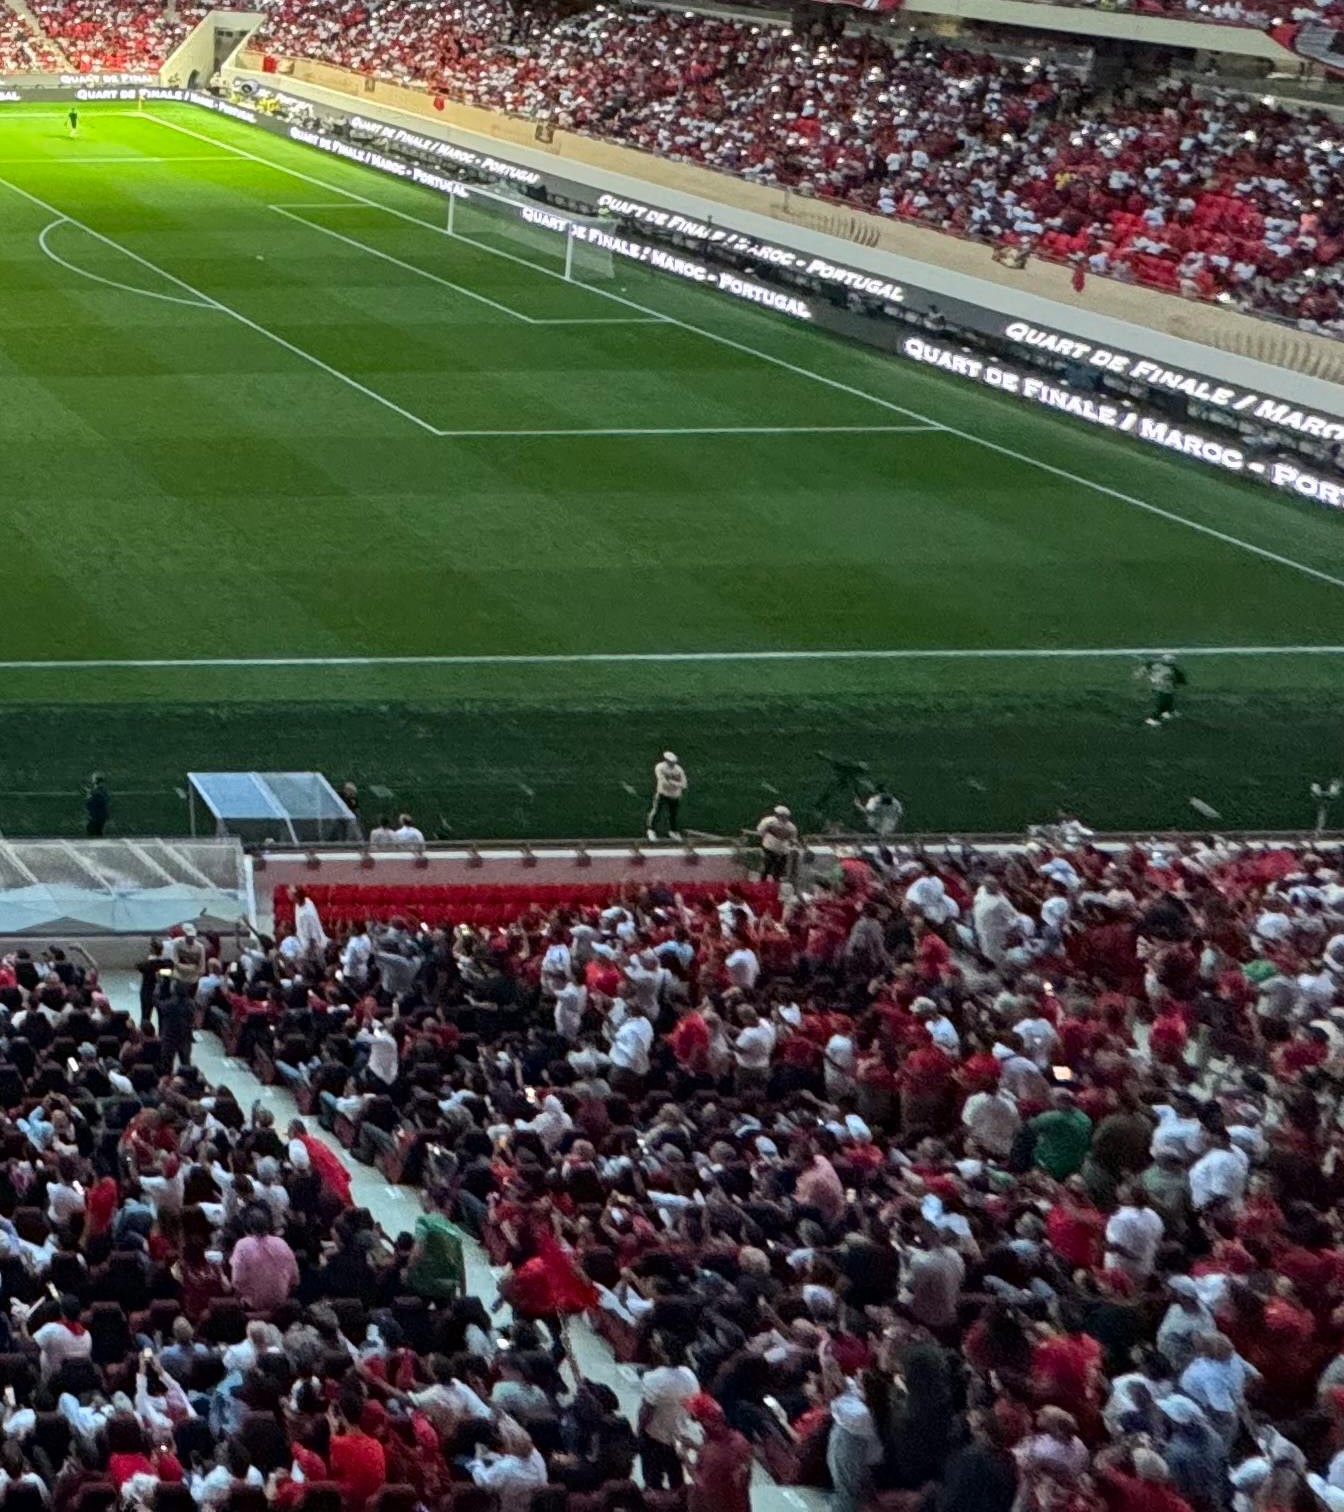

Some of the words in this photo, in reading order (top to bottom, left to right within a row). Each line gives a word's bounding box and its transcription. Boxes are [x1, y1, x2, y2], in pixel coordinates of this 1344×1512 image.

[523, 206, 567, 231] QUART
[588, 228, 641, 260] FINALE
[650, 250, 706, 280] MAROC
[717, 273, 811, 318] PORTUGAL
[646, 208, 669, 228] DE
[805, 259, 904, 301] PORTUGAL
[904, 338, 982, 377] QUART
[983, 365, 1019, 392] DE
[1022, 378, 1118, 426] FINALE
[1139, 418, 1243, 469] MAROC
[1006, 322, 1089, 358] QUART
[1089, 347, 1129, 372] DE
[1130, 361, 1235, 409] FINALE
